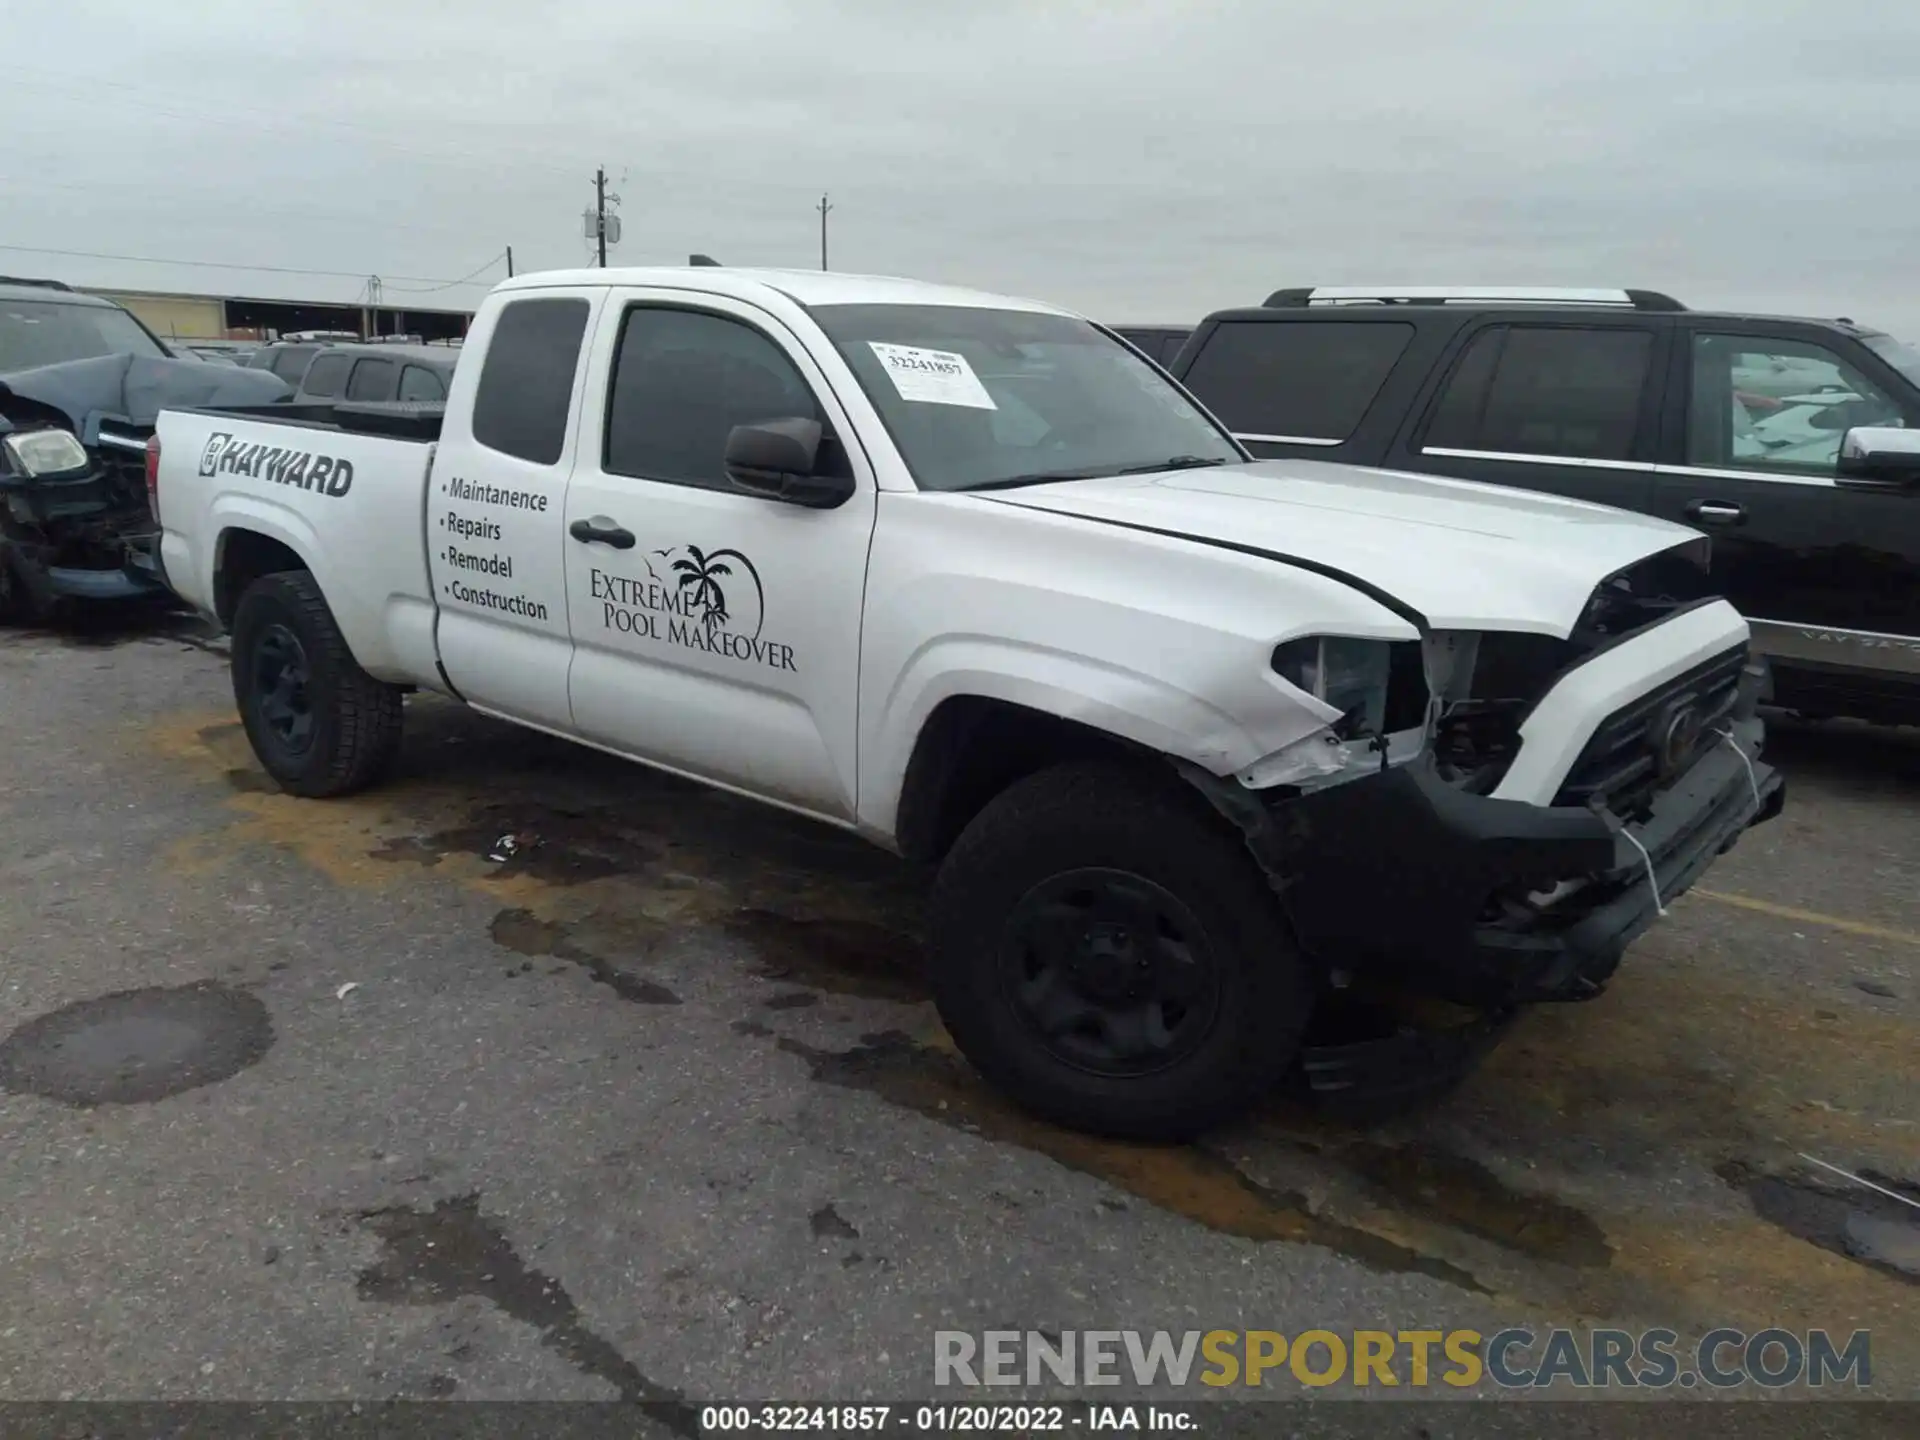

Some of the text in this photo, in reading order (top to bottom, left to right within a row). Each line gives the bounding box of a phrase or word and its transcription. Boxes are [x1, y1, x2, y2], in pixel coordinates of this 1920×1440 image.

[888, 355, 962, 375] 32241857
[218, 441, 354, 498] HAYWARD
[449, 477, 548, 511] Maintanence
[447, 511, 502, 541] Repairs
[448, 545, 513, 578] Remodel
[452, 580, 548, 621] Construction
[590, 567, 695, 618] EXTREME
[603, 602, 798, 673] POOL MAKEOVER
